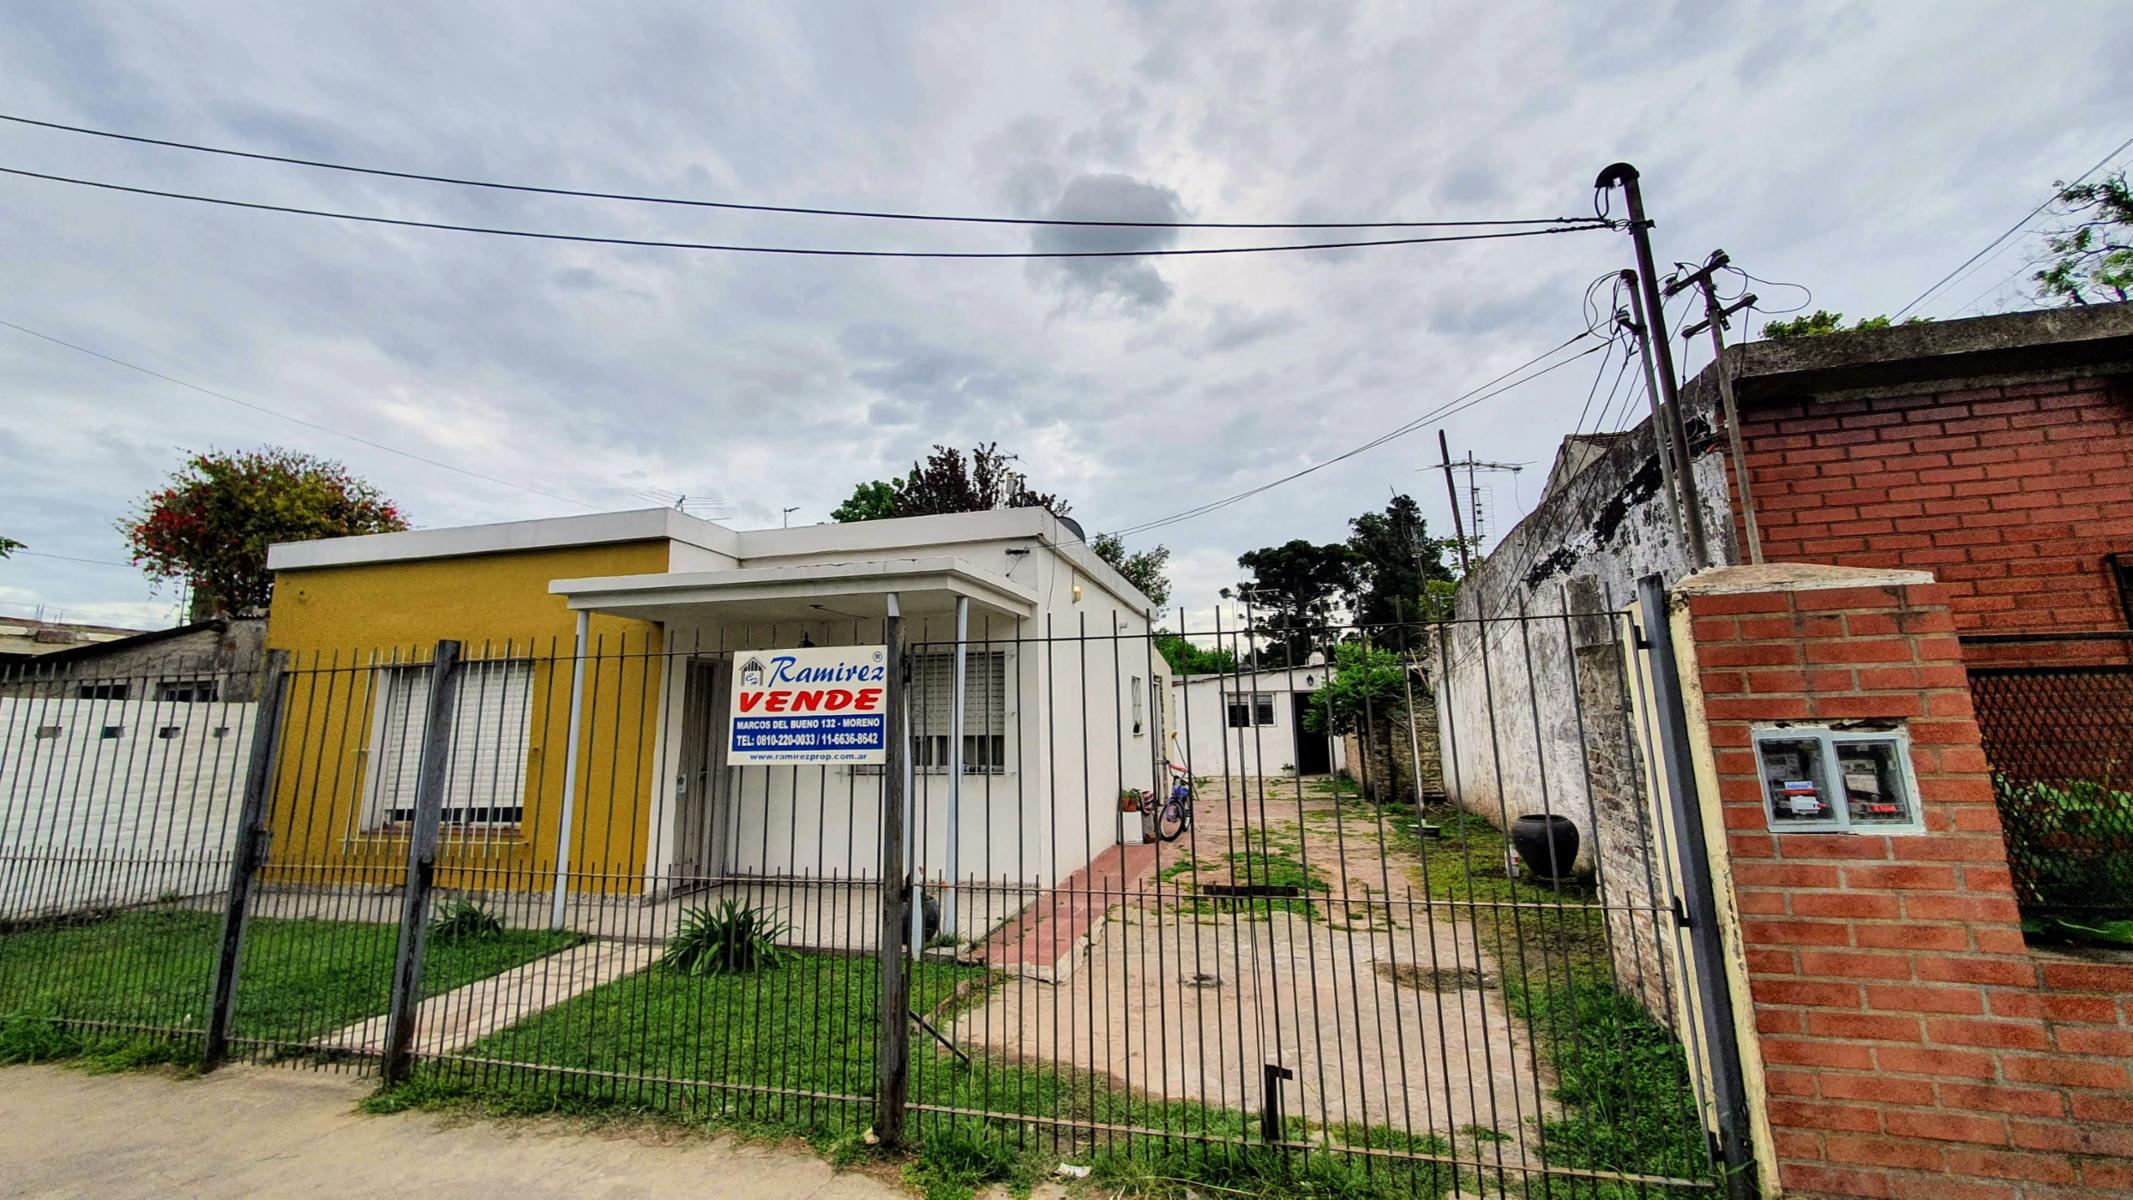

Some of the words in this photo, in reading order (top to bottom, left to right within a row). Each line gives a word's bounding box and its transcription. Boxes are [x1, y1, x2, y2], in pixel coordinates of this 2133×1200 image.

[768, 656, 884, 688] Ramirez
[740, 689, 883, 712] VENDE
[736, 720, 771, 730] MARCOS
[773, 720, 788, 729] DEL
[790, 719, 819, 729] BUENO
[821, 719, 836, 728] 132
[842, 718, 880, 727] MORENO
[736, 735, 755, 746] TEL:
[756, 734, 815, 746] 0810-220-0033
[750, 753, 867, 761] www.ramirezprop.com.ar
